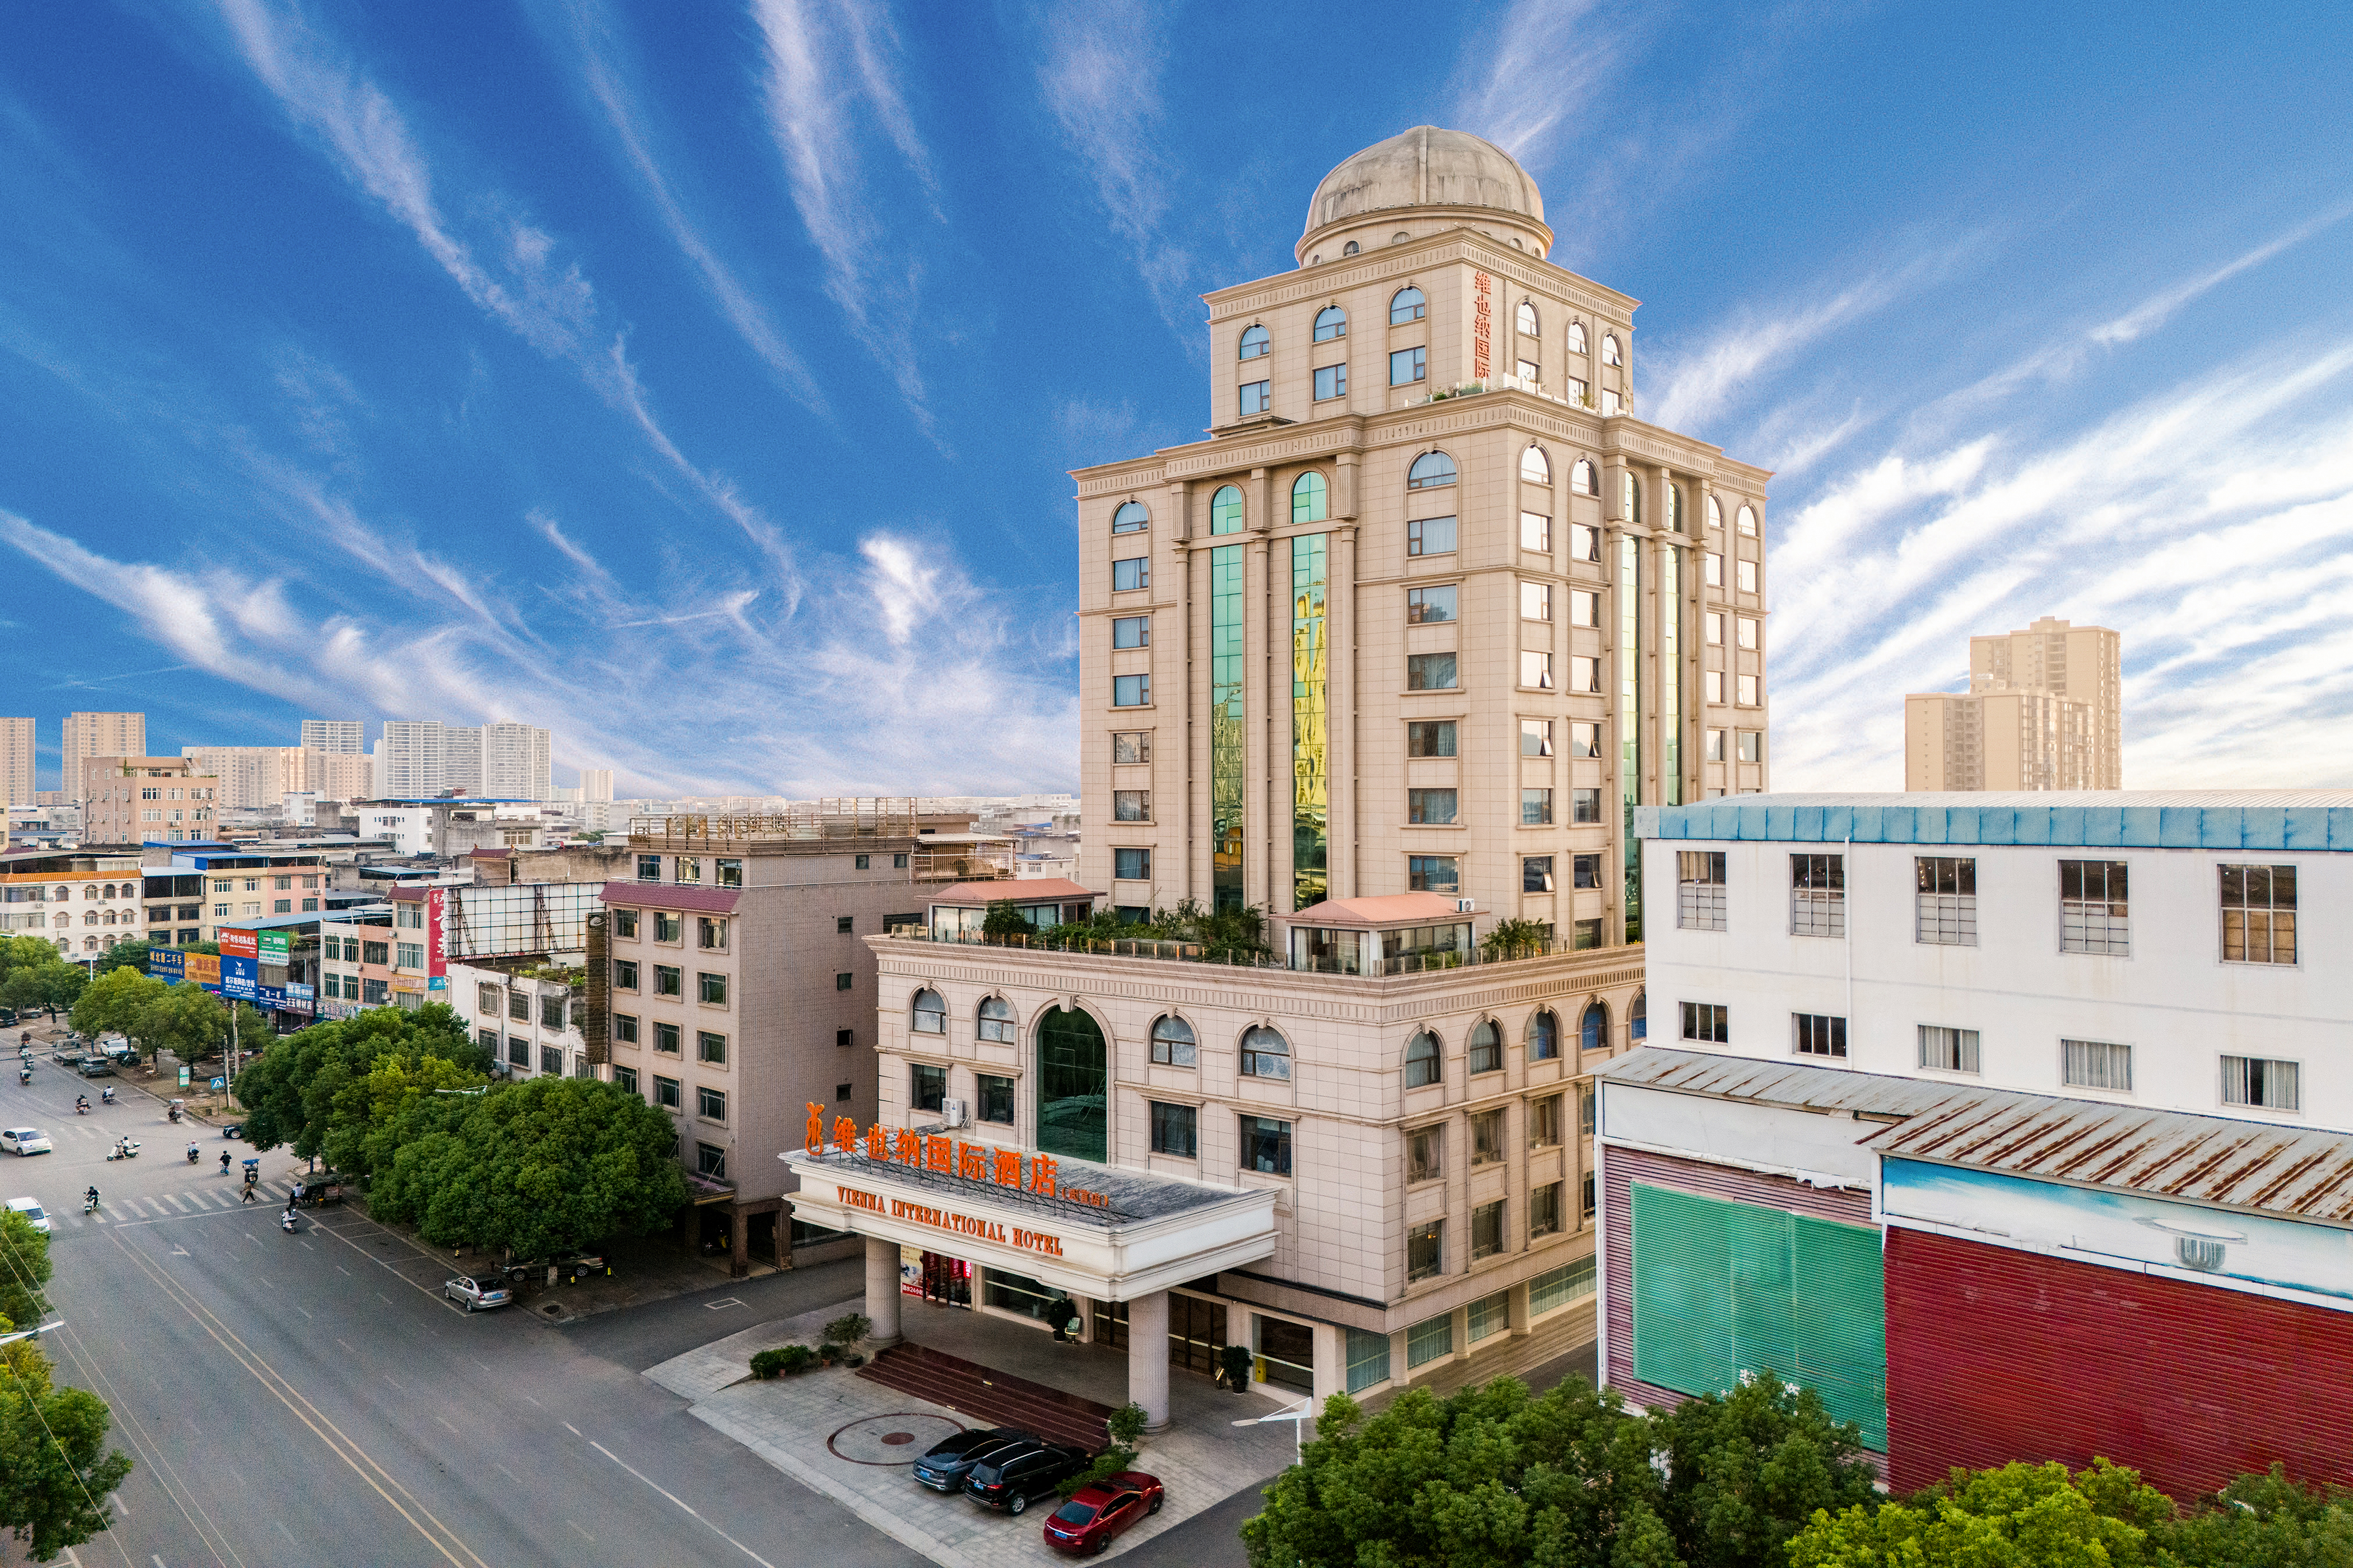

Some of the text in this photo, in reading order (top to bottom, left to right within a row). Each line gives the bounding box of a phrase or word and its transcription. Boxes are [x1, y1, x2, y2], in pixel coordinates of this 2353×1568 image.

[1474, 270, 1492, 379] 维也纳国际
[832, 1115, 1059, 1197] 维也纳国际酒店
[836, 1185, 1063, 1256] VIENNA INTERNATIONAL HOTEL
